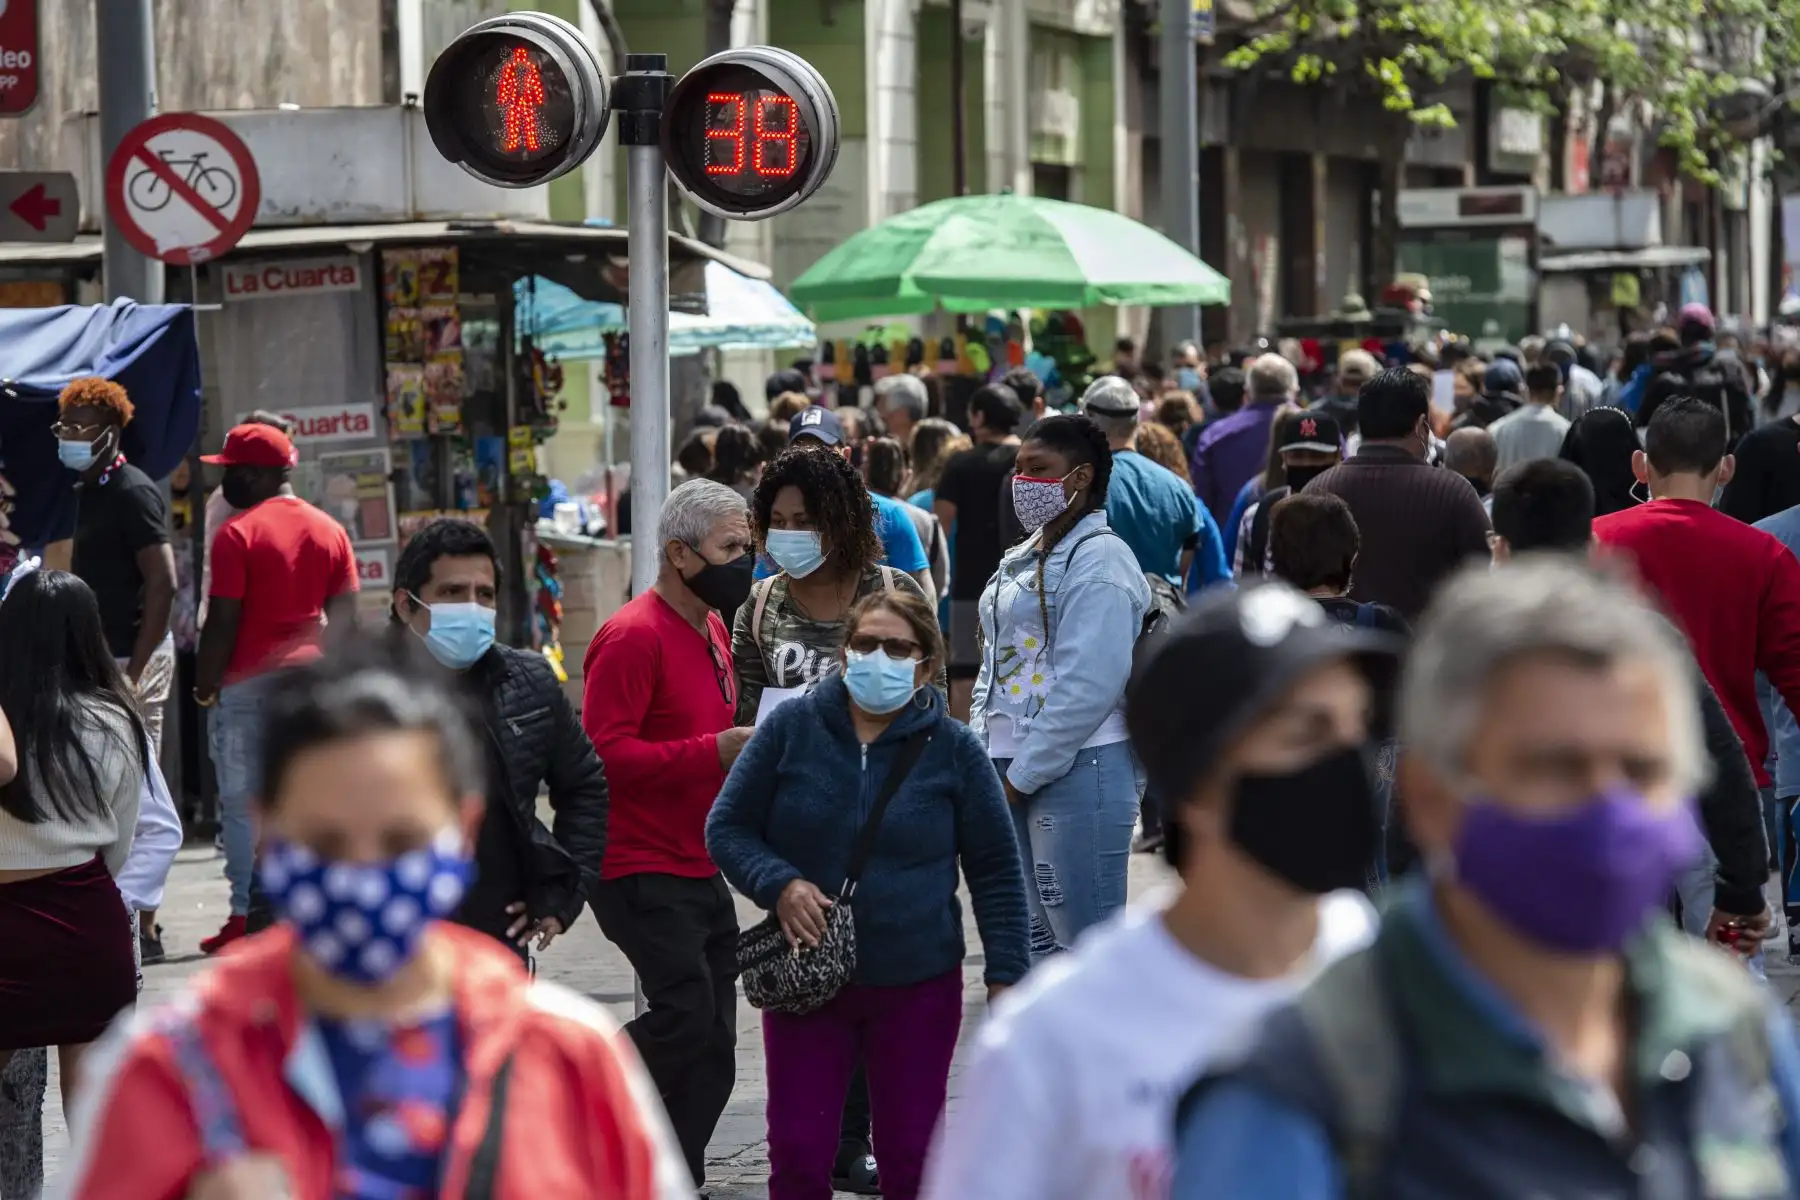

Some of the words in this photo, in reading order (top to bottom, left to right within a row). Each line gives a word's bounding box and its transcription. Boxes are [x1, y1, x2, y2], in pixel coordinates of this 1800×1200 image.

[705, 93, 797, 176] 38
[227, 272, 259, 294] La
[262, 263, 356, 290] Cuarta
